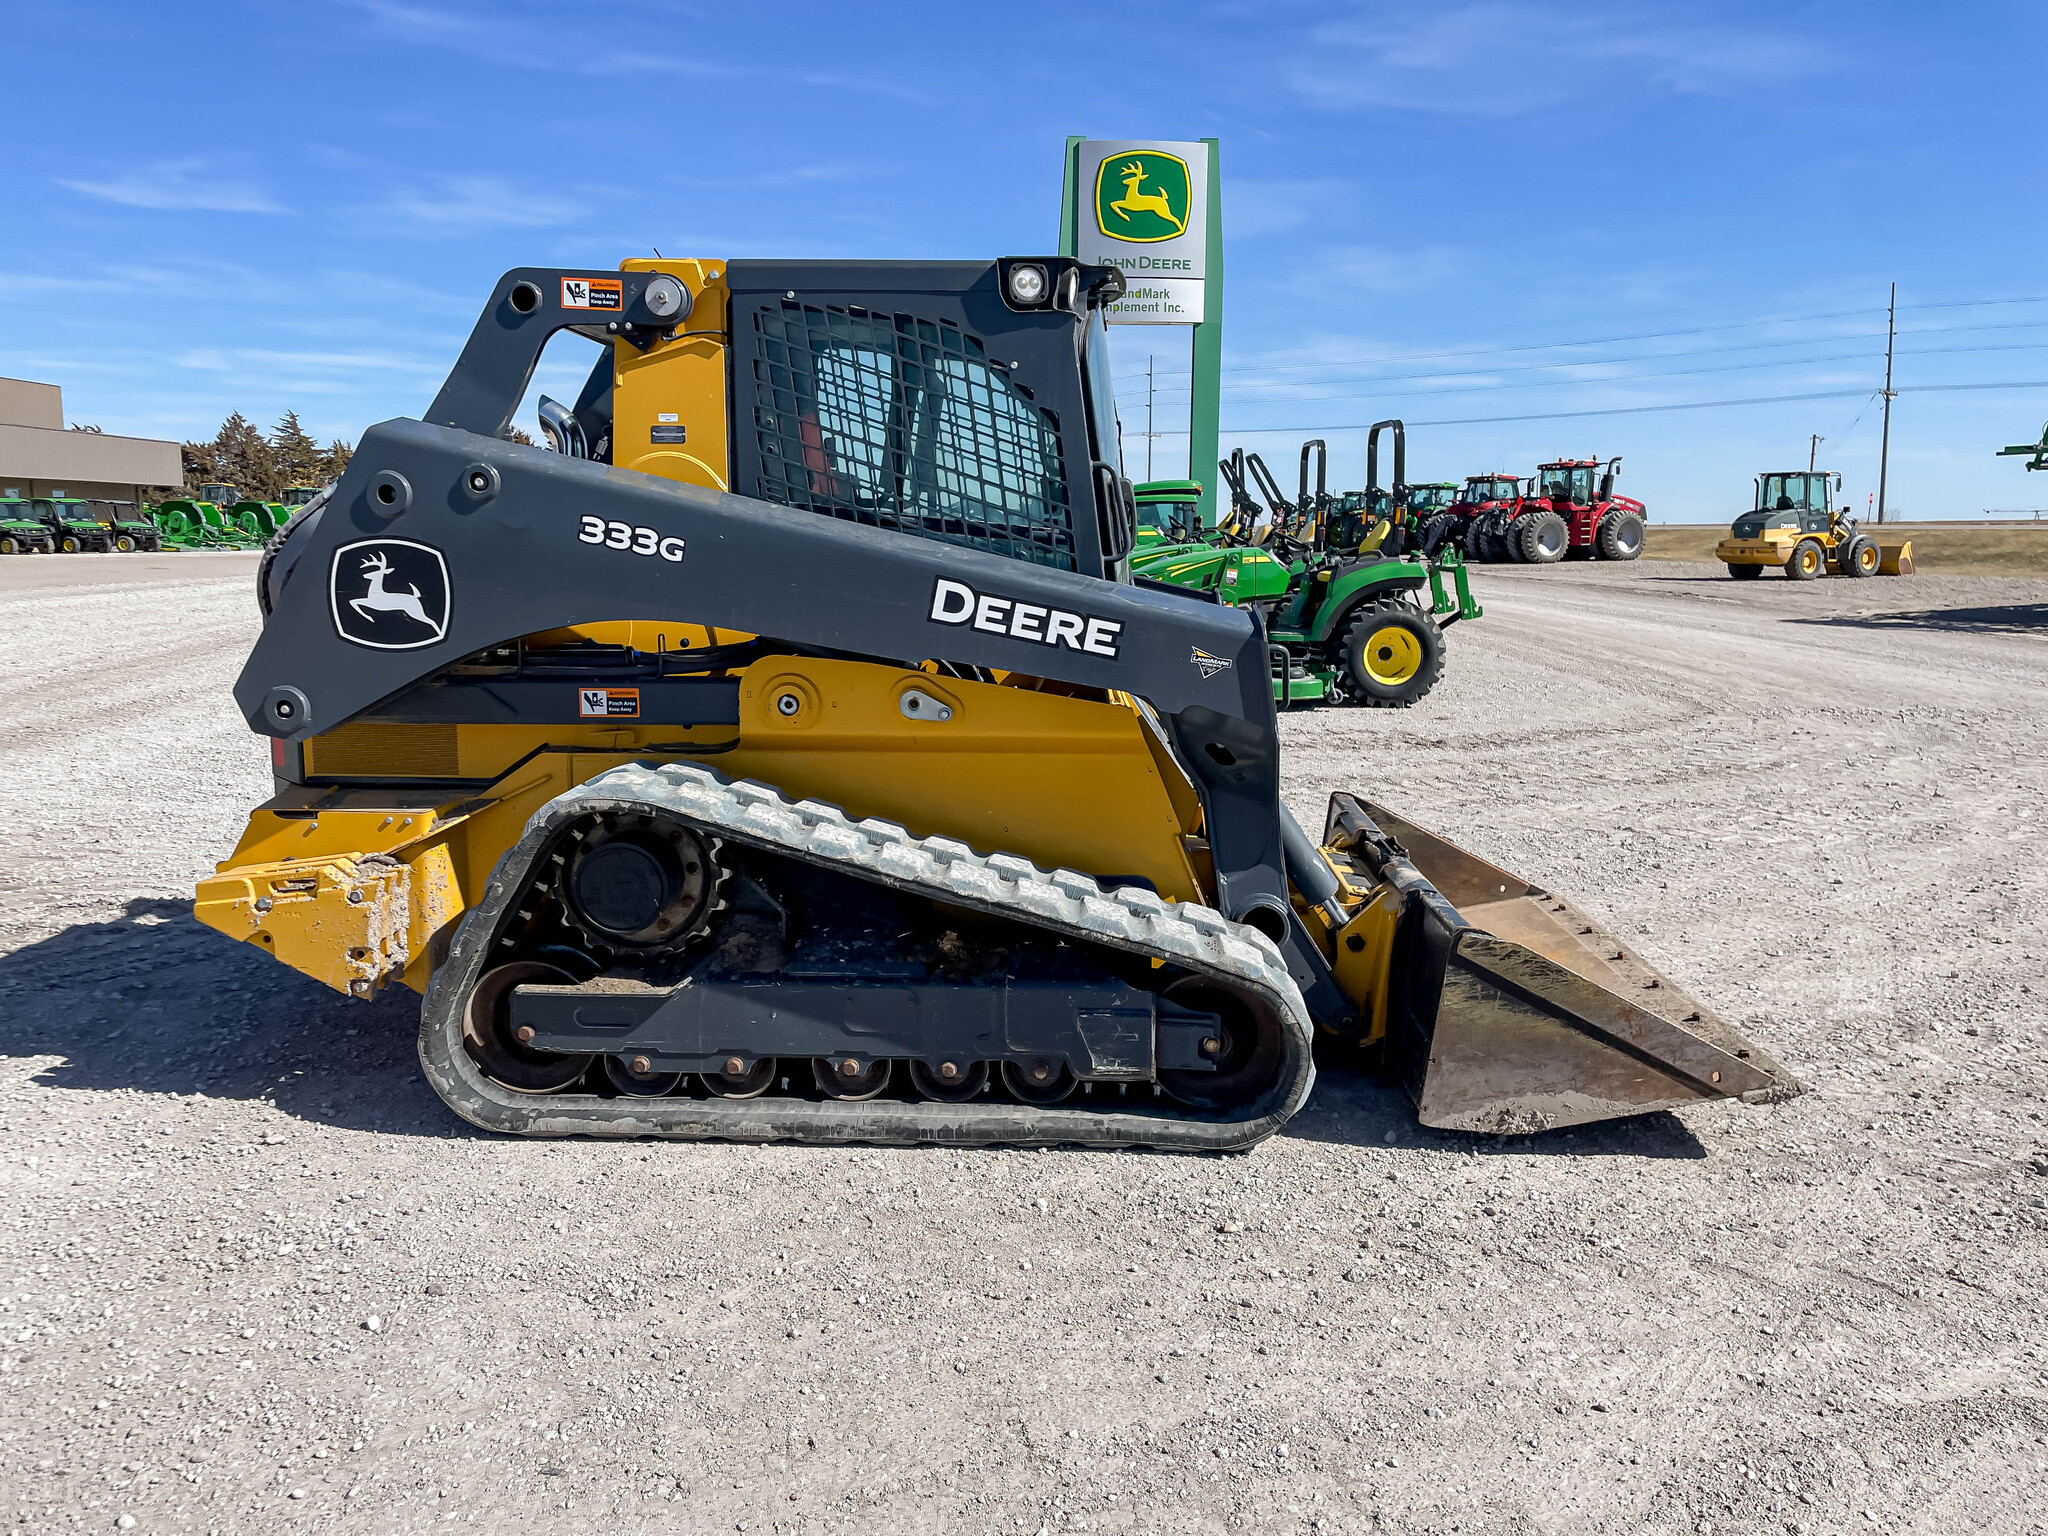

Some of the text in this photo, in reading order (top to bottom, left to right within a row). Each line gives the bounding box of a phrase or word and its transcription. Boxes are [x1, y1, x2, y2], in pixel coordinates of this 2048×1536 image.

[1098, 256, 1192, 270] JOHN DEERE
[1121, 288, 1170, 299] andMark
[1105, 301, 1185, 314] mplement Inc.
[579, 516, 685, 562] 333G
[931, 578, 1122, 657] DEERE
